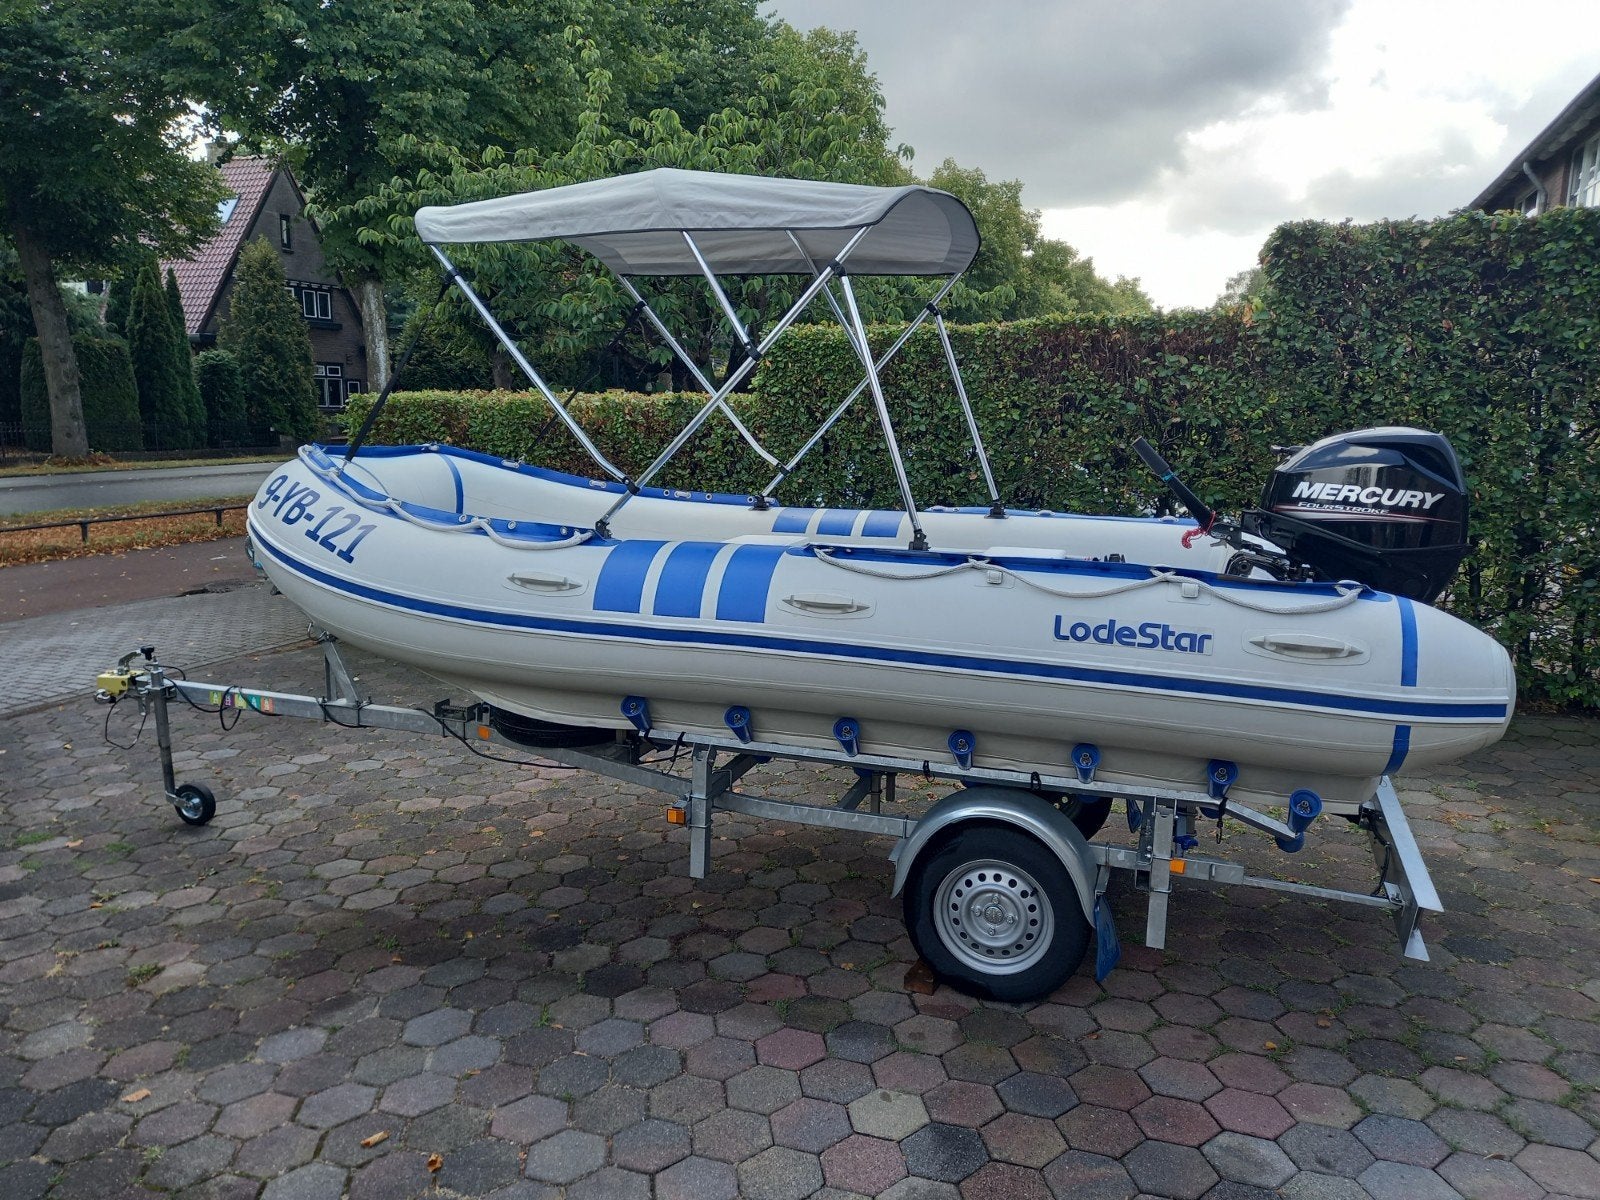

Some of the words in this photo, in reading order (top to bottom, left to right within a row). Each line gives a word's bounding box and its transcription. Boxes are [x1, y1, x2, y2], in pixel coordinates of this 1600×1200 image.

[1292, 482, 1446, 510] MERCURY
[1297, 501, 1390, 515] FOURSTROKE
[258, 475, 378, 564] 9-YB-121
[1054, 615, 1212, 653] LodeStar
